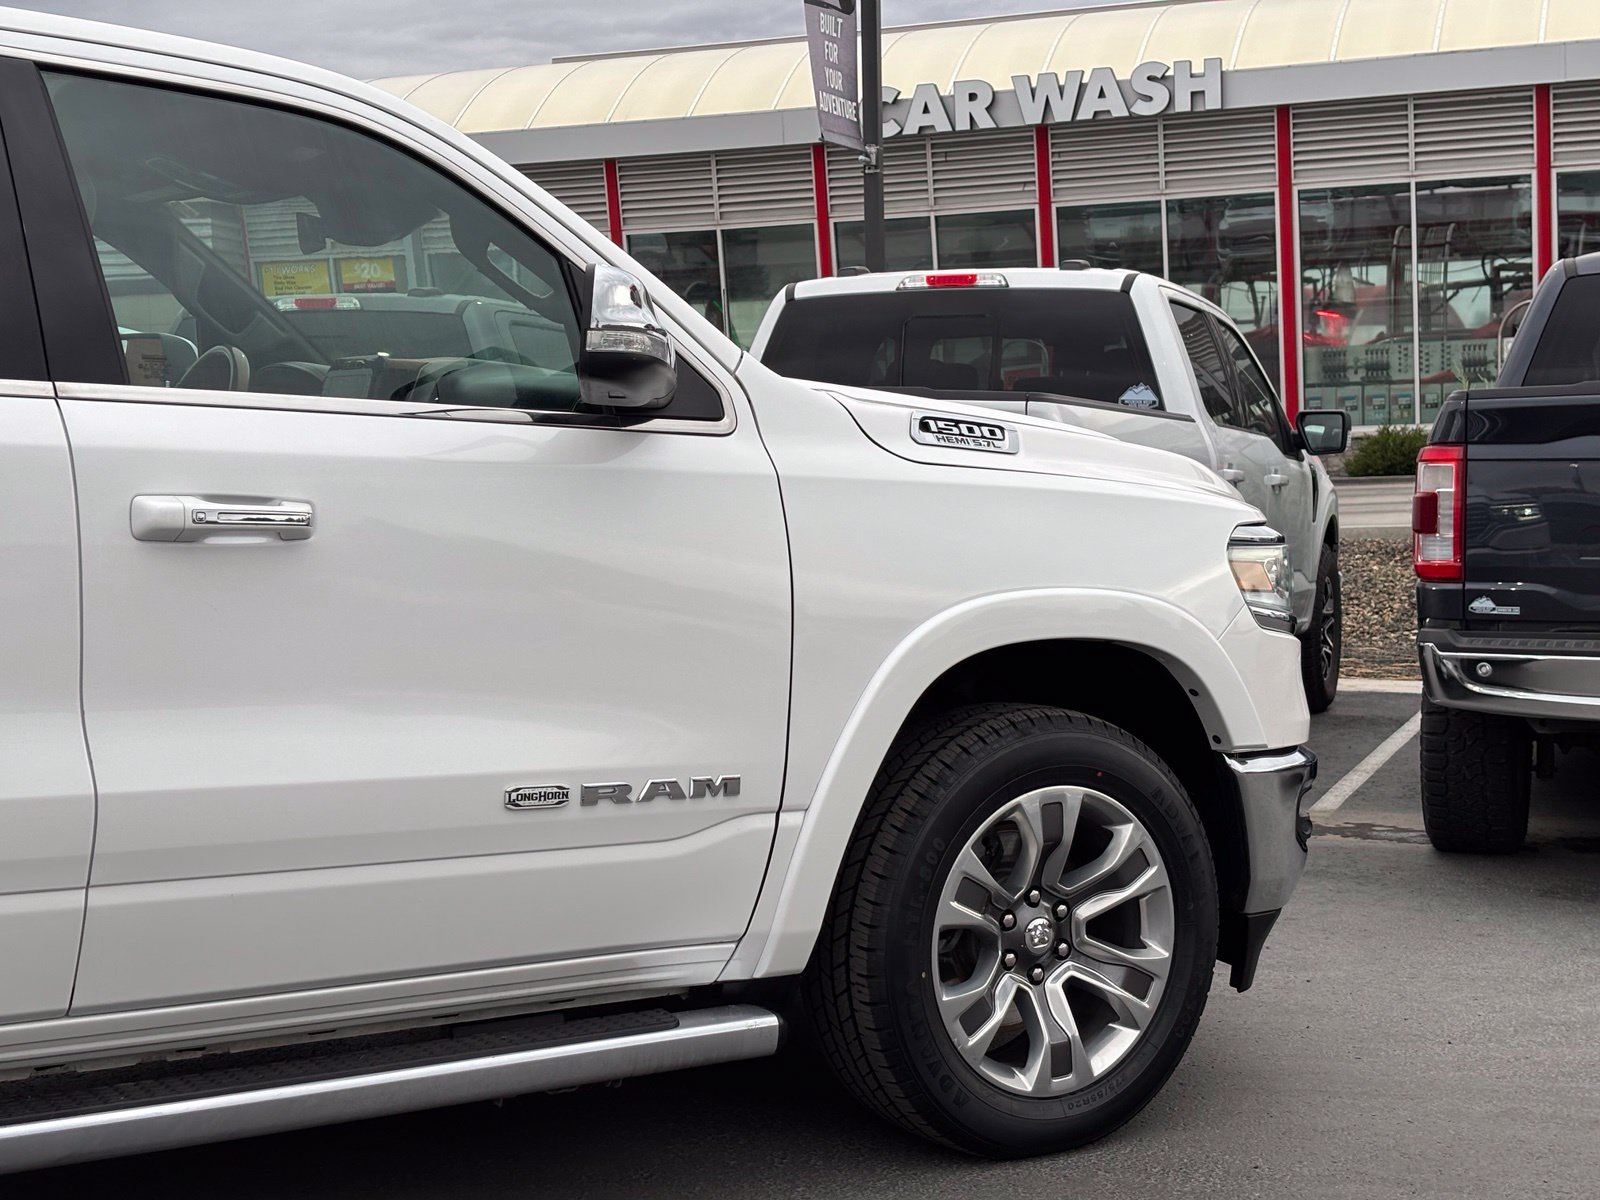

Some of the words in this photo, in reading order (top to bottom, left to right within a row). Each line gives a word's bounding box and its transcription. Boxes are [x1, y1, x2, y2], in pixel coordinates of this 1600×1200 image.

[819, 12, 843, 38] BUILT
[824, 40, 839, 64] FOR
[824, 66, 844, 91] YOUR
[819, 90, 857, 121] ADVENTURE
[866, 79, 997, 139] CAR
[1011, 57, 1222, 126] WASH
[921, 418, 1004, 441] 1500
[935, 434, 970, 446] HEMI
[973, 439, 1002, 450] 5.7L
[508, 790, 570, 803] LONGHORN
[580, 774, 741, 806] RAM
